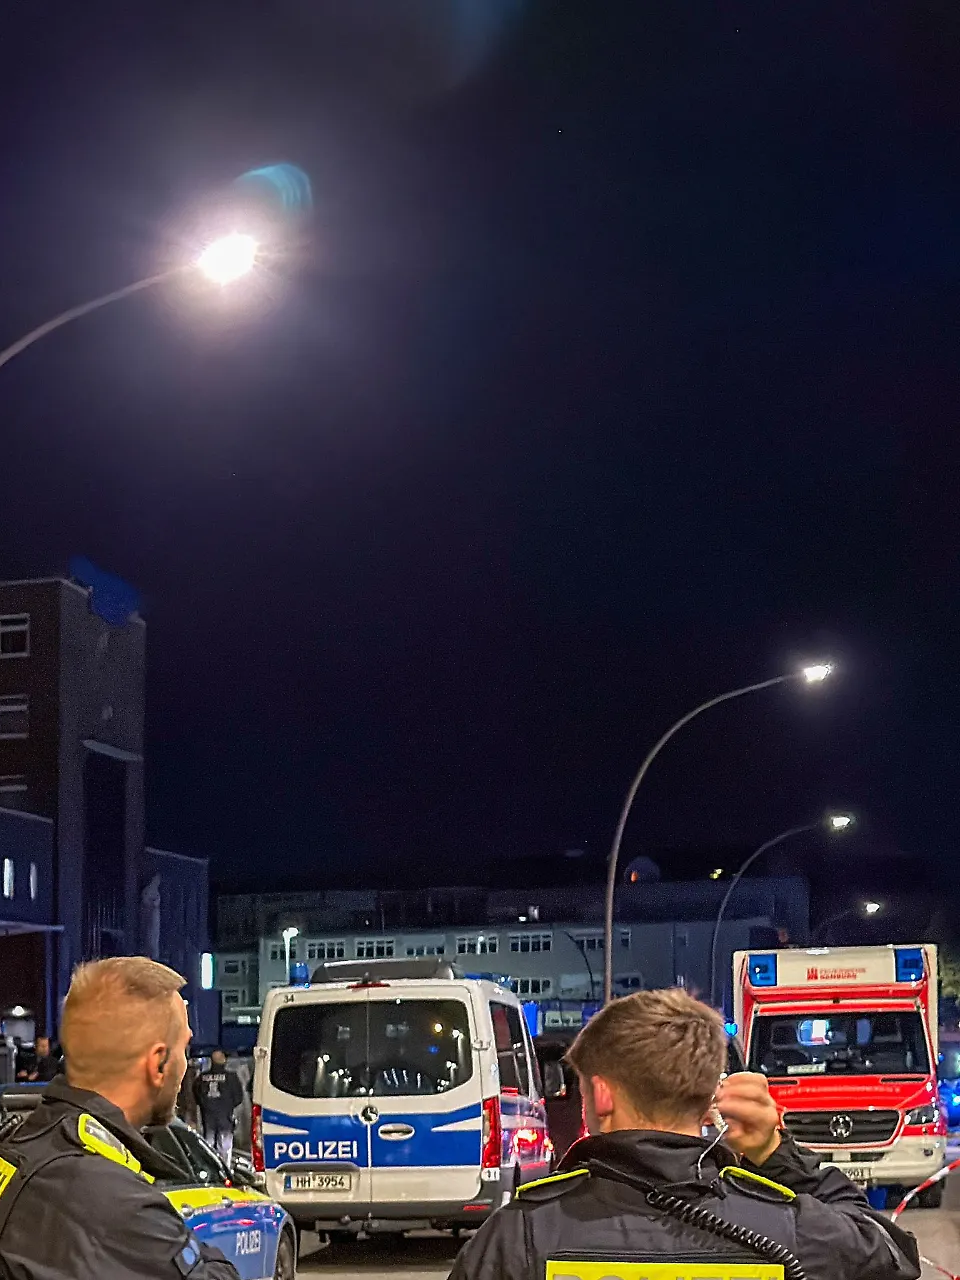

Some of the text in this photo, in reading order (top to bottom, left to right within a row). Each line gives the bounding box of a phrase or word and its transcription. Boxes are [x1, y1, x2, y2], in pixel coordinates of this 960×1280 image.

[284, 994, 294, 1003] 34
[274, 1140, 358, 1160] POLIZEI
[296, 1174, 345, 1187] HH 3954
[235, 1230, 261, 1256] POLIZEI
